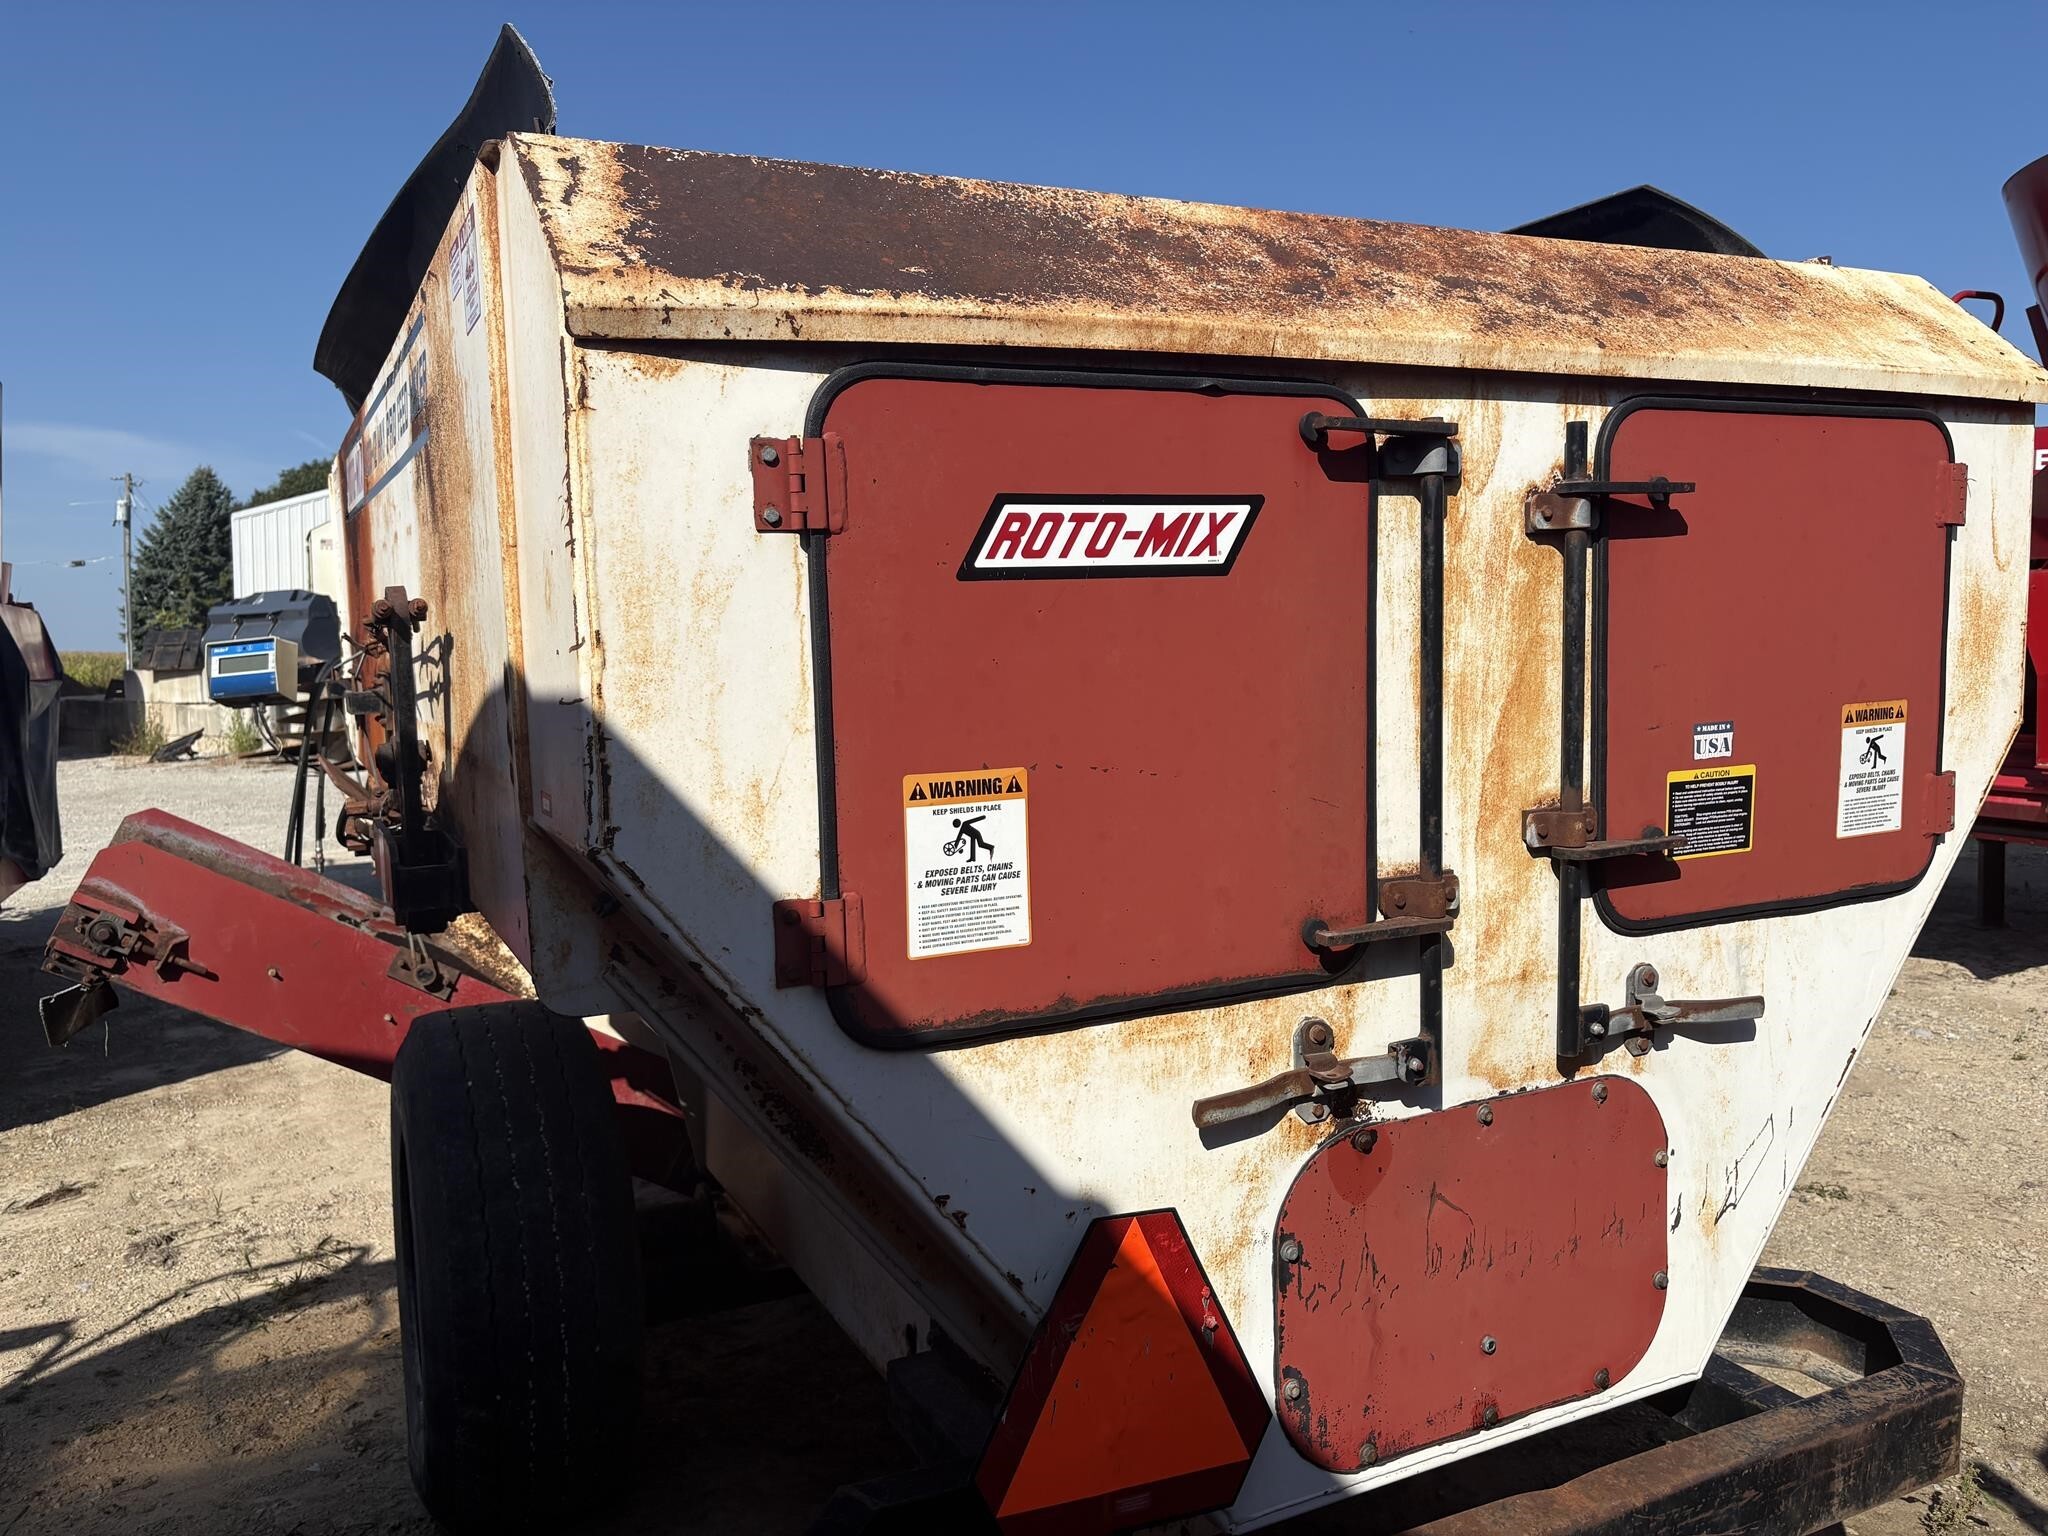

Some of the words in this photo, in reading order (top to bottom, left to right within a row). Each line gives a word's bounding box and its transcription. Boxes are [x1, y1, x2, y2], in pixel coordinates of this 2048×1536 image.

[985, 512, 1238, 560] ROTO-MIX
[1855, 706, 1894, 723] WARNING
[1702, 724, 1717, 732] MADE
[1695, 736, 1731, 755] USA
[1700, 769, 1731, 779] CAUTION
[1848, 780, 1864, 788] MOVING
[1887, 775, 1900, 783] CAUSE
[1849, 772, 1867, 780] EXPOSED
[1881, 769, 1896, 777] CHAINS
[929, 777, 1003, 799] WARNING
[1856, 786, 1872, 794] SEVERE
[1872, 784, 1887, 792] INJURY
[932, 808, 948, 816] KEEP
[949, 806, 974, 815] SHIELDS
[975, 805, 982, 813] IN
[983, 804, 1002, 812] PLACE
[925, 867, 958, 879] EXPOSED
[960, 865, 986, 877] BELTS,
[987, 862, 1013, 874] CHAINS
[917, 880, 923, 889] &
[924, 877, 954, 889] MOVING
[955, 874, 979, 886] PARTS
[981, 873, 996, 883] CAN
[998, 870, 1021, 881] CAUSE
[941, 885, 969, 897] SEVERE
[970, 882, 997, 894] INJURY
